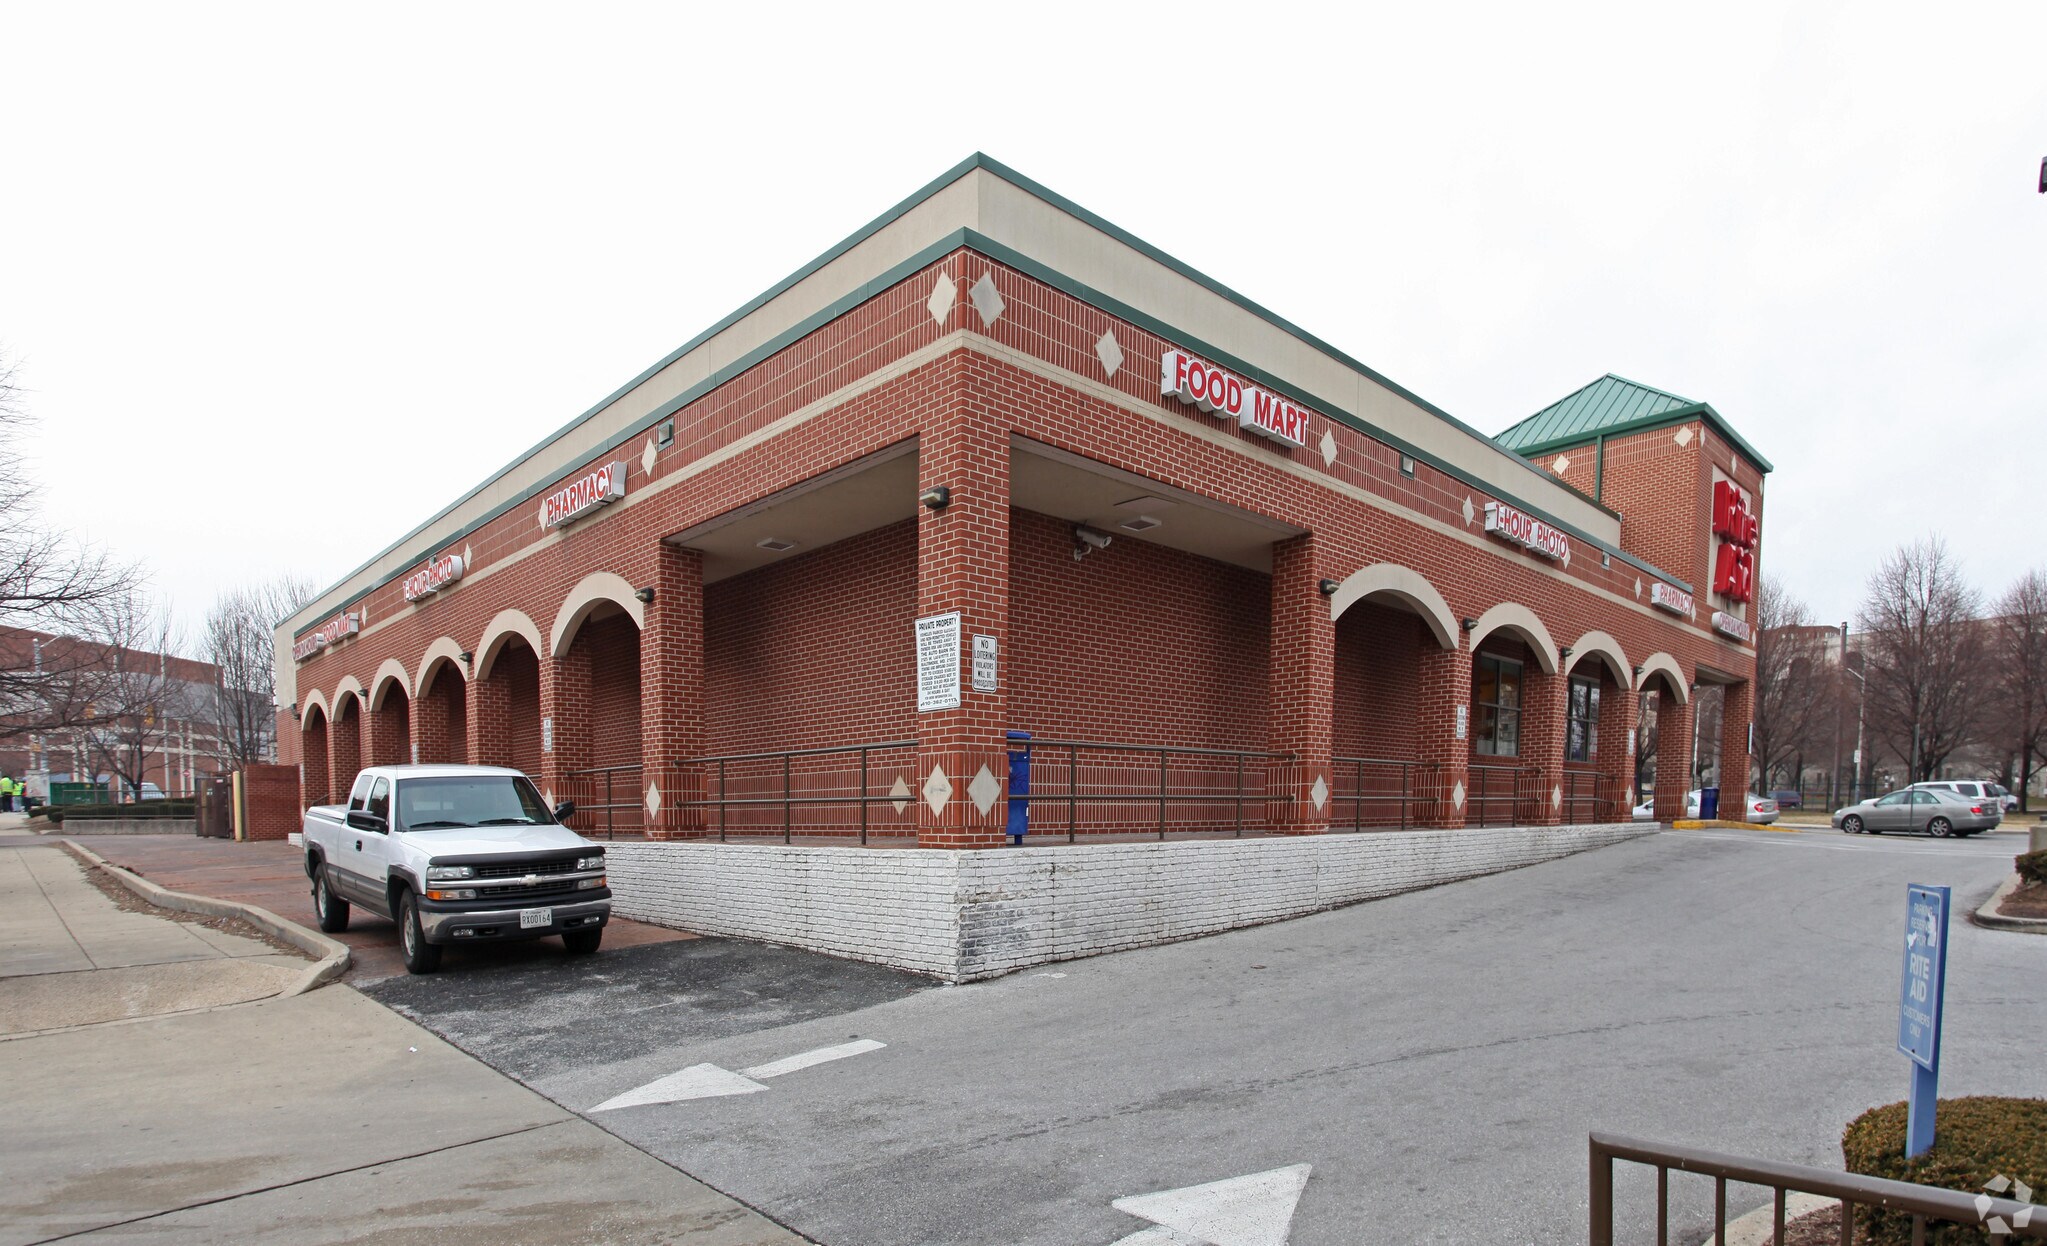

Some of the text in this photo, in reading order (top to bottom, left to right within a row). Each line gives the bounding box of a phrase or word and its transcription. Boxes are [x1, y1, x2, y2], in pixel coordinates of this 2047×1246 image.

[1175, 353, 1308, 443] FOOD MART
[547, 463, 615, 525] PHARMACY
[1495, 503, 1567, 559] 1-HOUR PHOTO
[403, 556, 453, 602] 1-HOUR PHOTO
[1660, 584, 1692, 616] PHARMACY
[919, 617, 956, 631] PRIVATE PROPERTY
[974, 650, 995, 660] LOITERING
[981, 640, 988, 650] NO
[1910, 952, 1930, 981] RITE
[1909, 979, 1927, 1003] AID
[1903, 1004, 1930, 1028] CUSTOMERS
